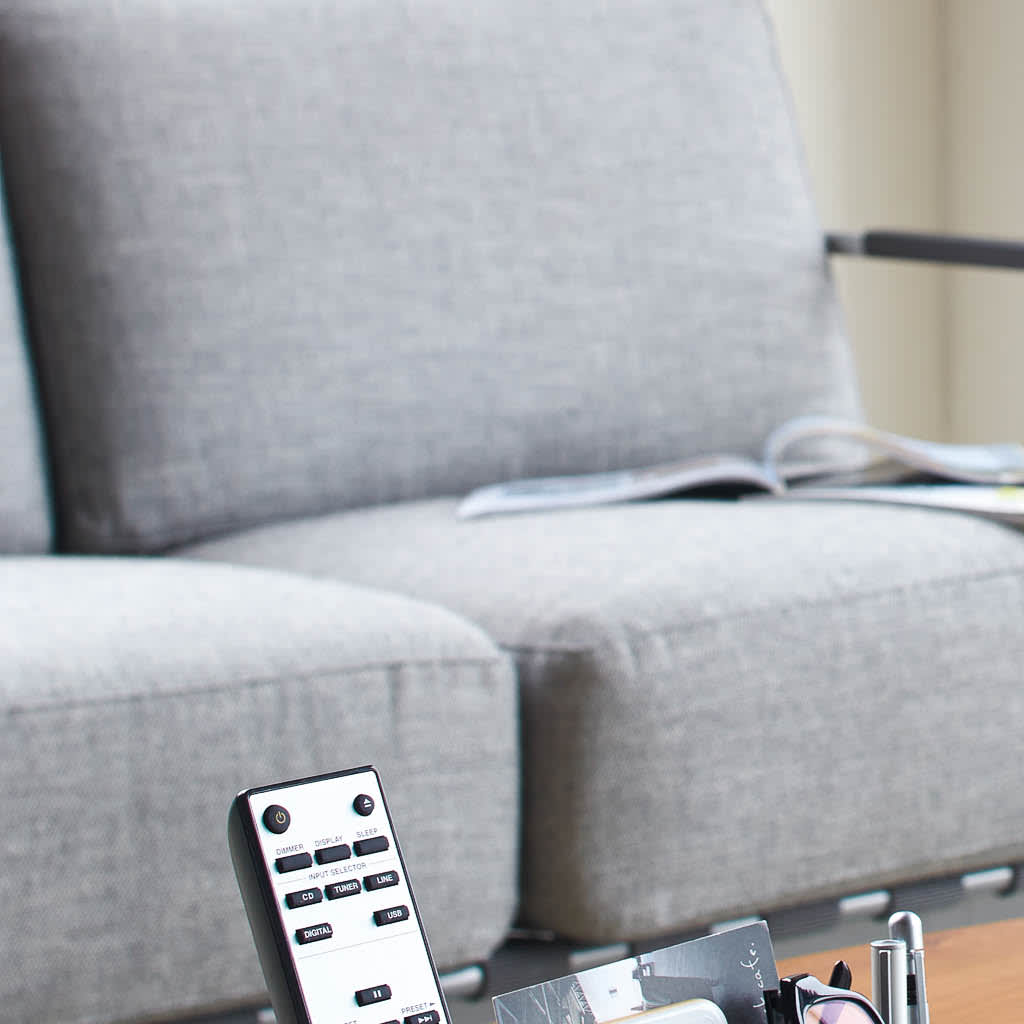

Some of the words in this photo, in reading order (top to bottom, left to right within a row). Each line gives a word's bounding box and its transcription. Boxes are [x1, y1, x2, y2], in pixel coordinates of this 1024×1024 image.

[356, 828, 378, 838] SLEEP
[314, 835, 343, 847] DISPLAY
[276, 844, 304, 855] DIMMER
[309, 870, 329, 880] INPUT
[330, 863, 366, 875] SELECTOR
[376, 874, 393, 884] LINE
[334, 882, 358, 893] TUNER
[302, 892, 314, 901] CD
[387, 909, 402, 919] USB
[304, 926, 332, 938] DIGITAL
[401, 1003, 427, 1014] PRESET
